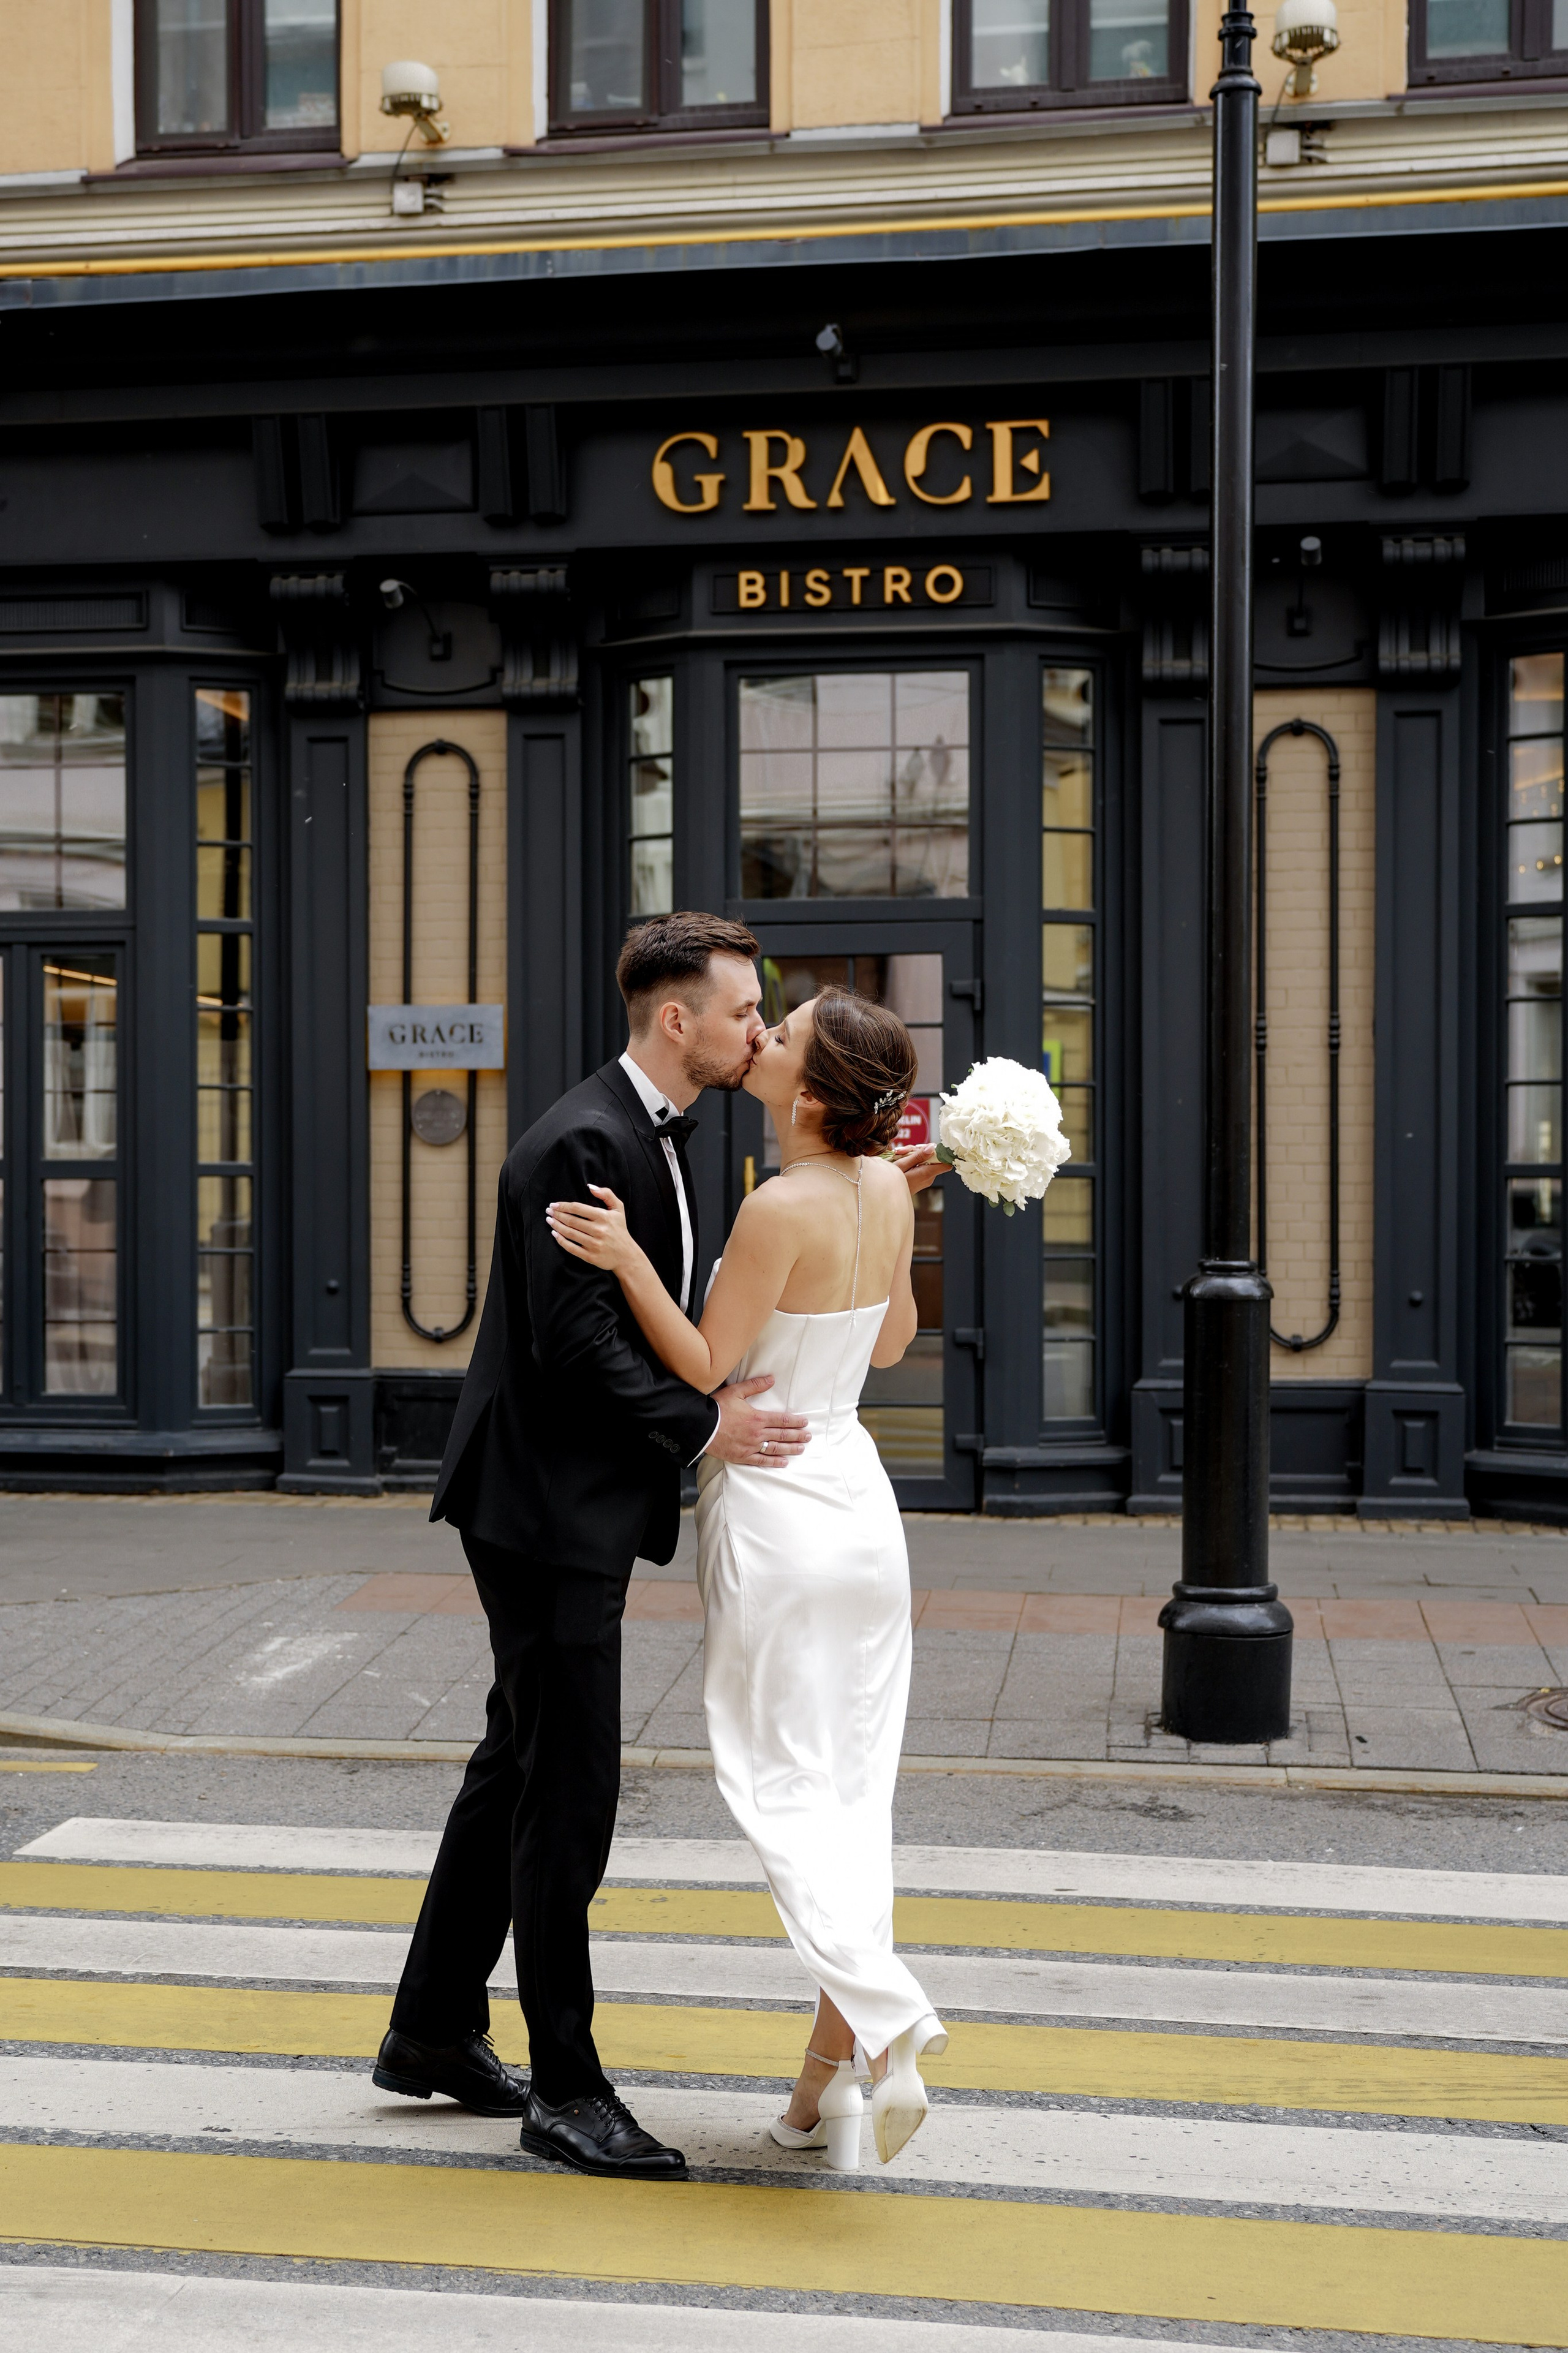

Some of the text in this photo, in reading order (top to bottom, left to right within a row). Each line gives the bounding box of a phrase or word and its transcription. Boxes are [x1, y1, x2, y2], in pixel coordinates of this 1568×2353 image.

[652, 420, 1050, 513] GRACE
[738, 564, 964, 608] BISTRO
[389, 1022, 483, 1044] GRACE
